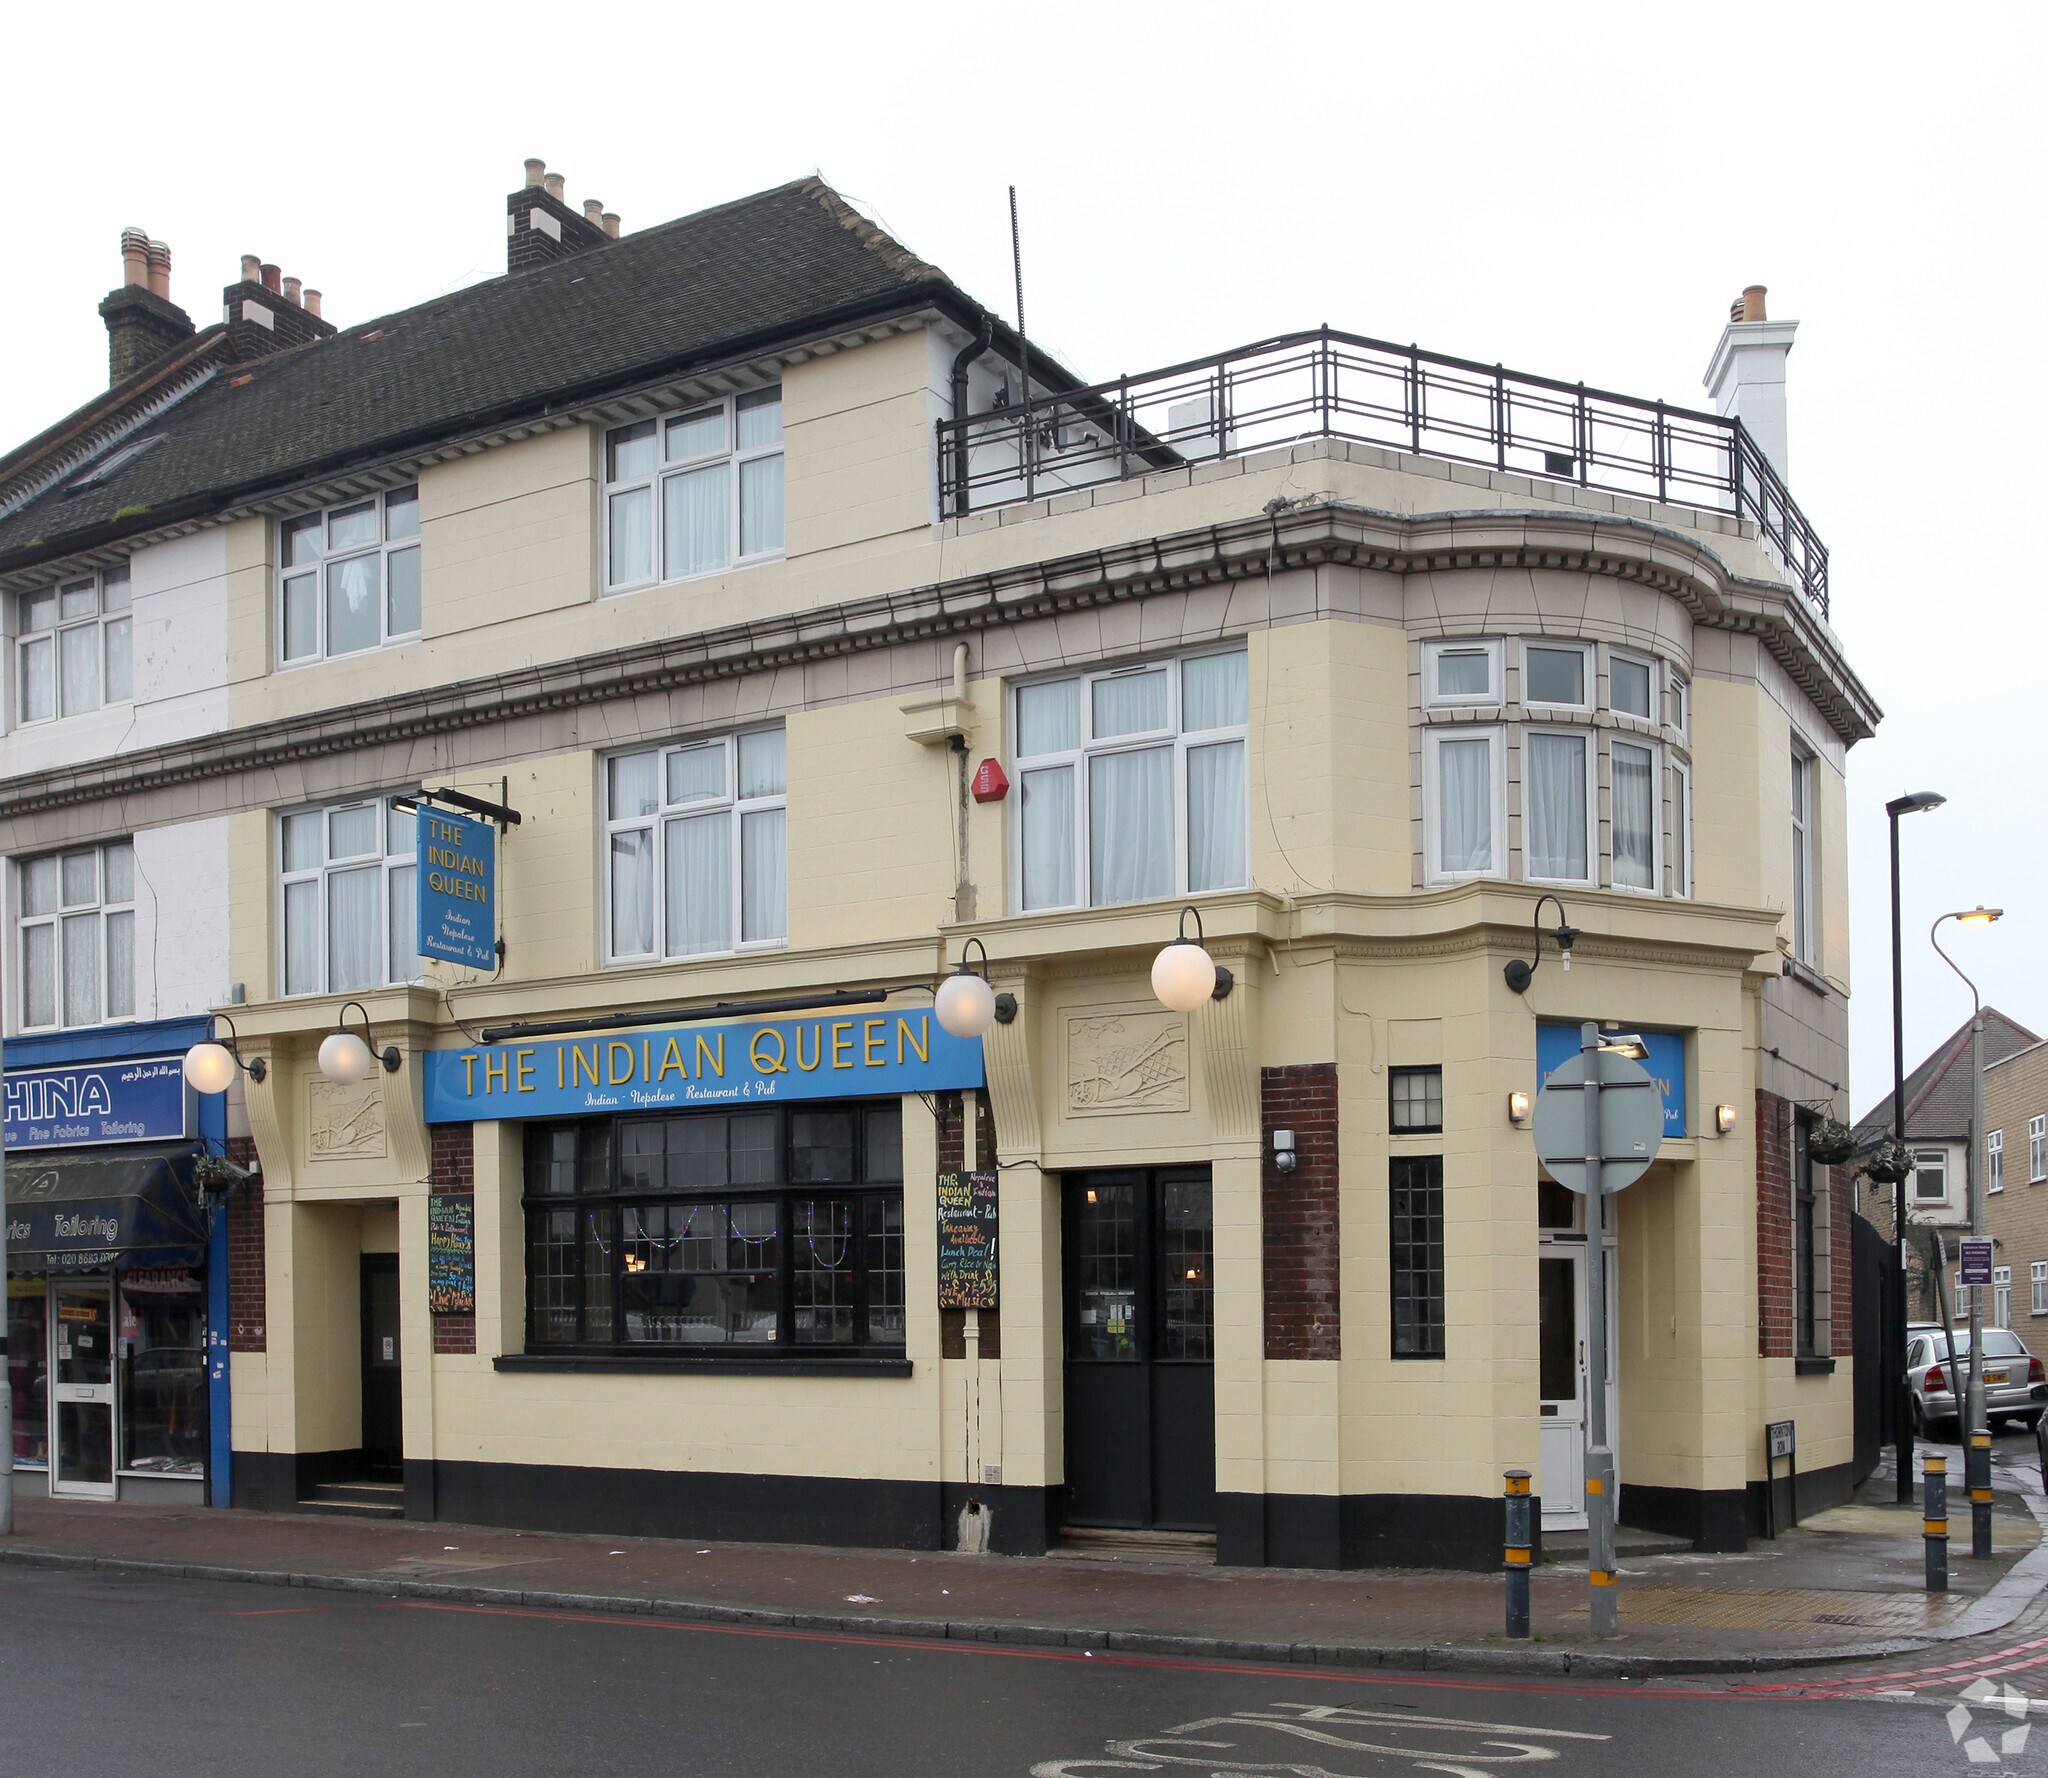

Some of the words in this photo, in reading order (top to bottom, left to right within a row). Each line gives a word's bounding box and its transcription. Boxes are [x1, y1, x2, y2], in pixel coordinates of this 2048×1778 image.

[429, 819, 463, 846] THE
[428, 845, 484, 878] INDIAN
[429, 871, 486, 904] QUEEN
[445, 909, 471, 926] Indian
[441, 923, 476, 943] Nepalese
[426, 935, 465, 956] Restaurant
[467, 945, 473, 957] &
[476, 946, 490, 961] Pub
[460, 1049, 536, 1097] THE
[557, 1032, 724, 1089] INDIAN
[750, 1016, 929, 1075] QUEEN
[584, 1092, 618, 1106] Indian
[630, 1088, 676, 1108] Nepalese
[685, 1084, 738, 1100] Restaurant
[742, 1082, 750, 1096] &
[755, 1080, 776, 1095] Pub
[29, 1126, 51, 1141] Fine
[53, 1124, 90, 1140] Fabrics
[101, 1120, 145, 1137] Tailoring
[938, 1182, 972, 1197] INDIAN
[938, 1205, 977, 1221] Restaurant
[984, 1203, 997, 1219] Pub
[939, 1195, 973, 1208] QUEEN
[55, 1214, 119, 1241] Tailoring
[61, 1253, 77, 1265] 020
[940, 1244, 965, 1257] Lunch
[968, 1243, 990, 1258] Deal
